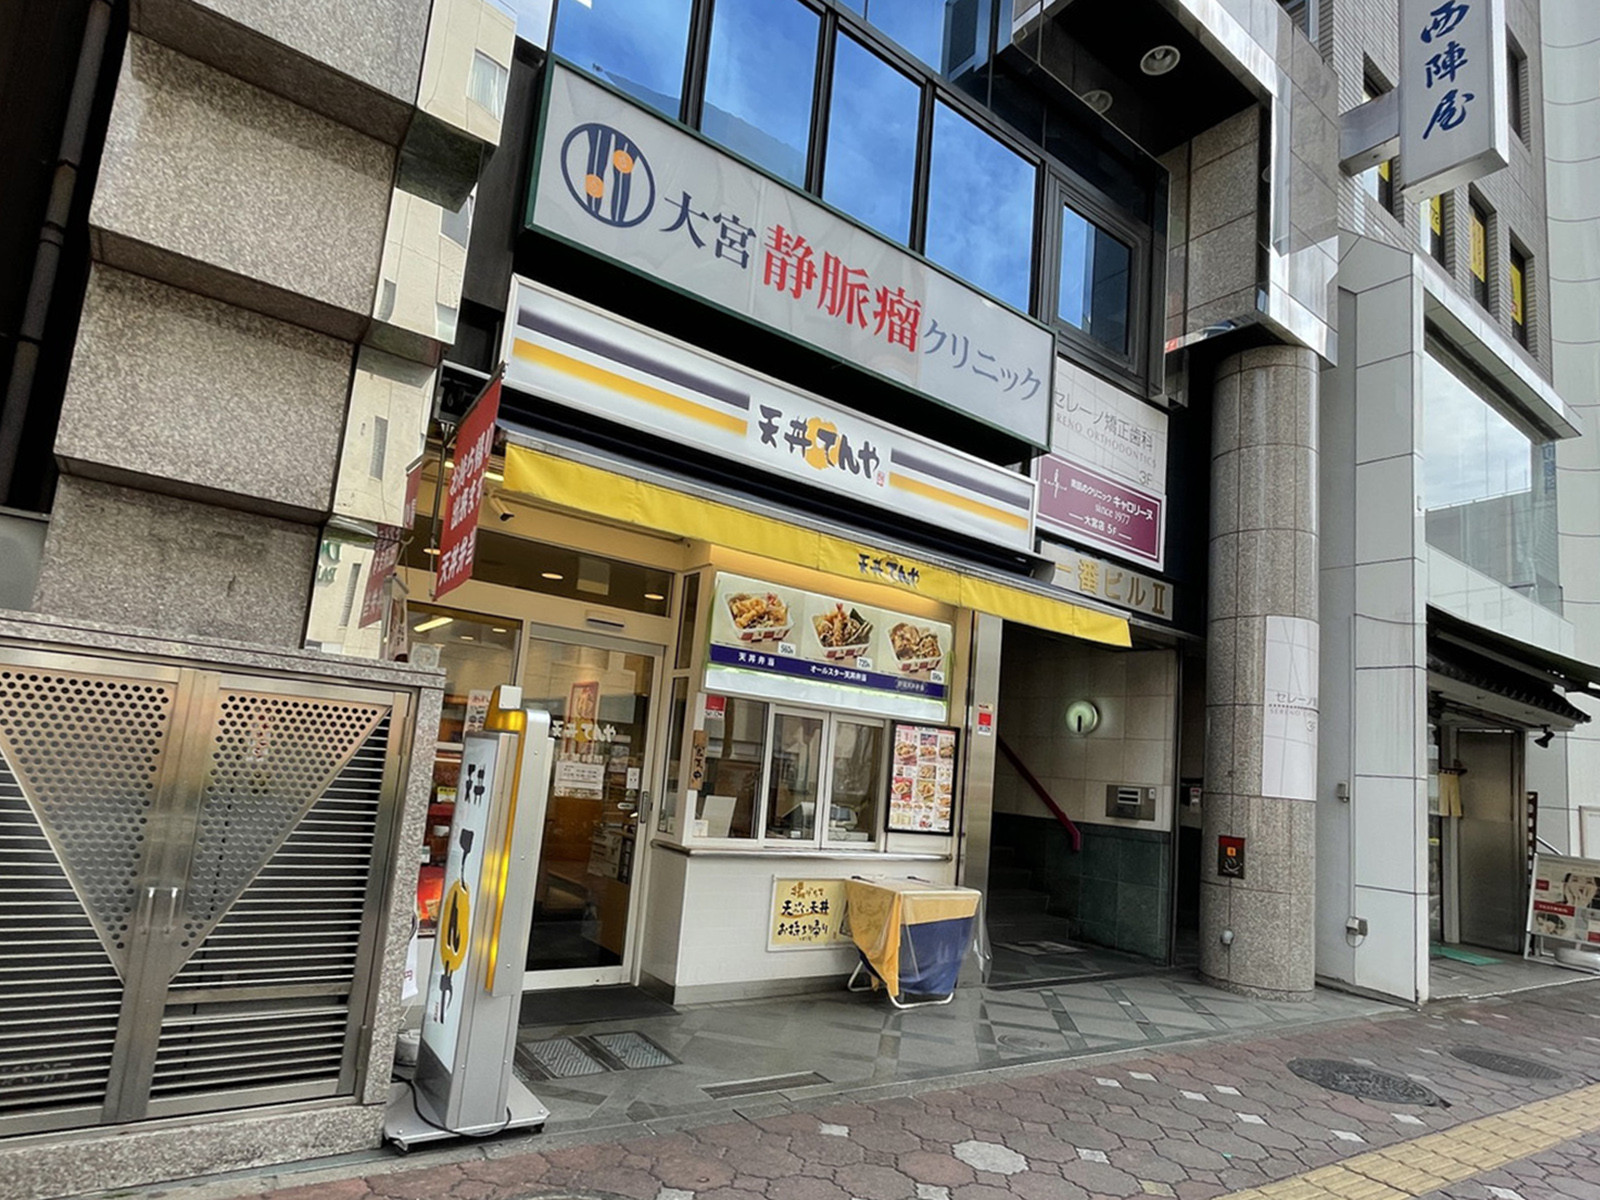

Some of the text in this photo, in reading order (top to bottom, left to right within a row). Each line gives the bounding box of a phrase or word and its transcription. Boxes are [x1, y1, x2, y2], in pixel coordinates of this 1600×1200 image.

[659, 190, 1042, 401] 大宮静脈瘤クリニック
